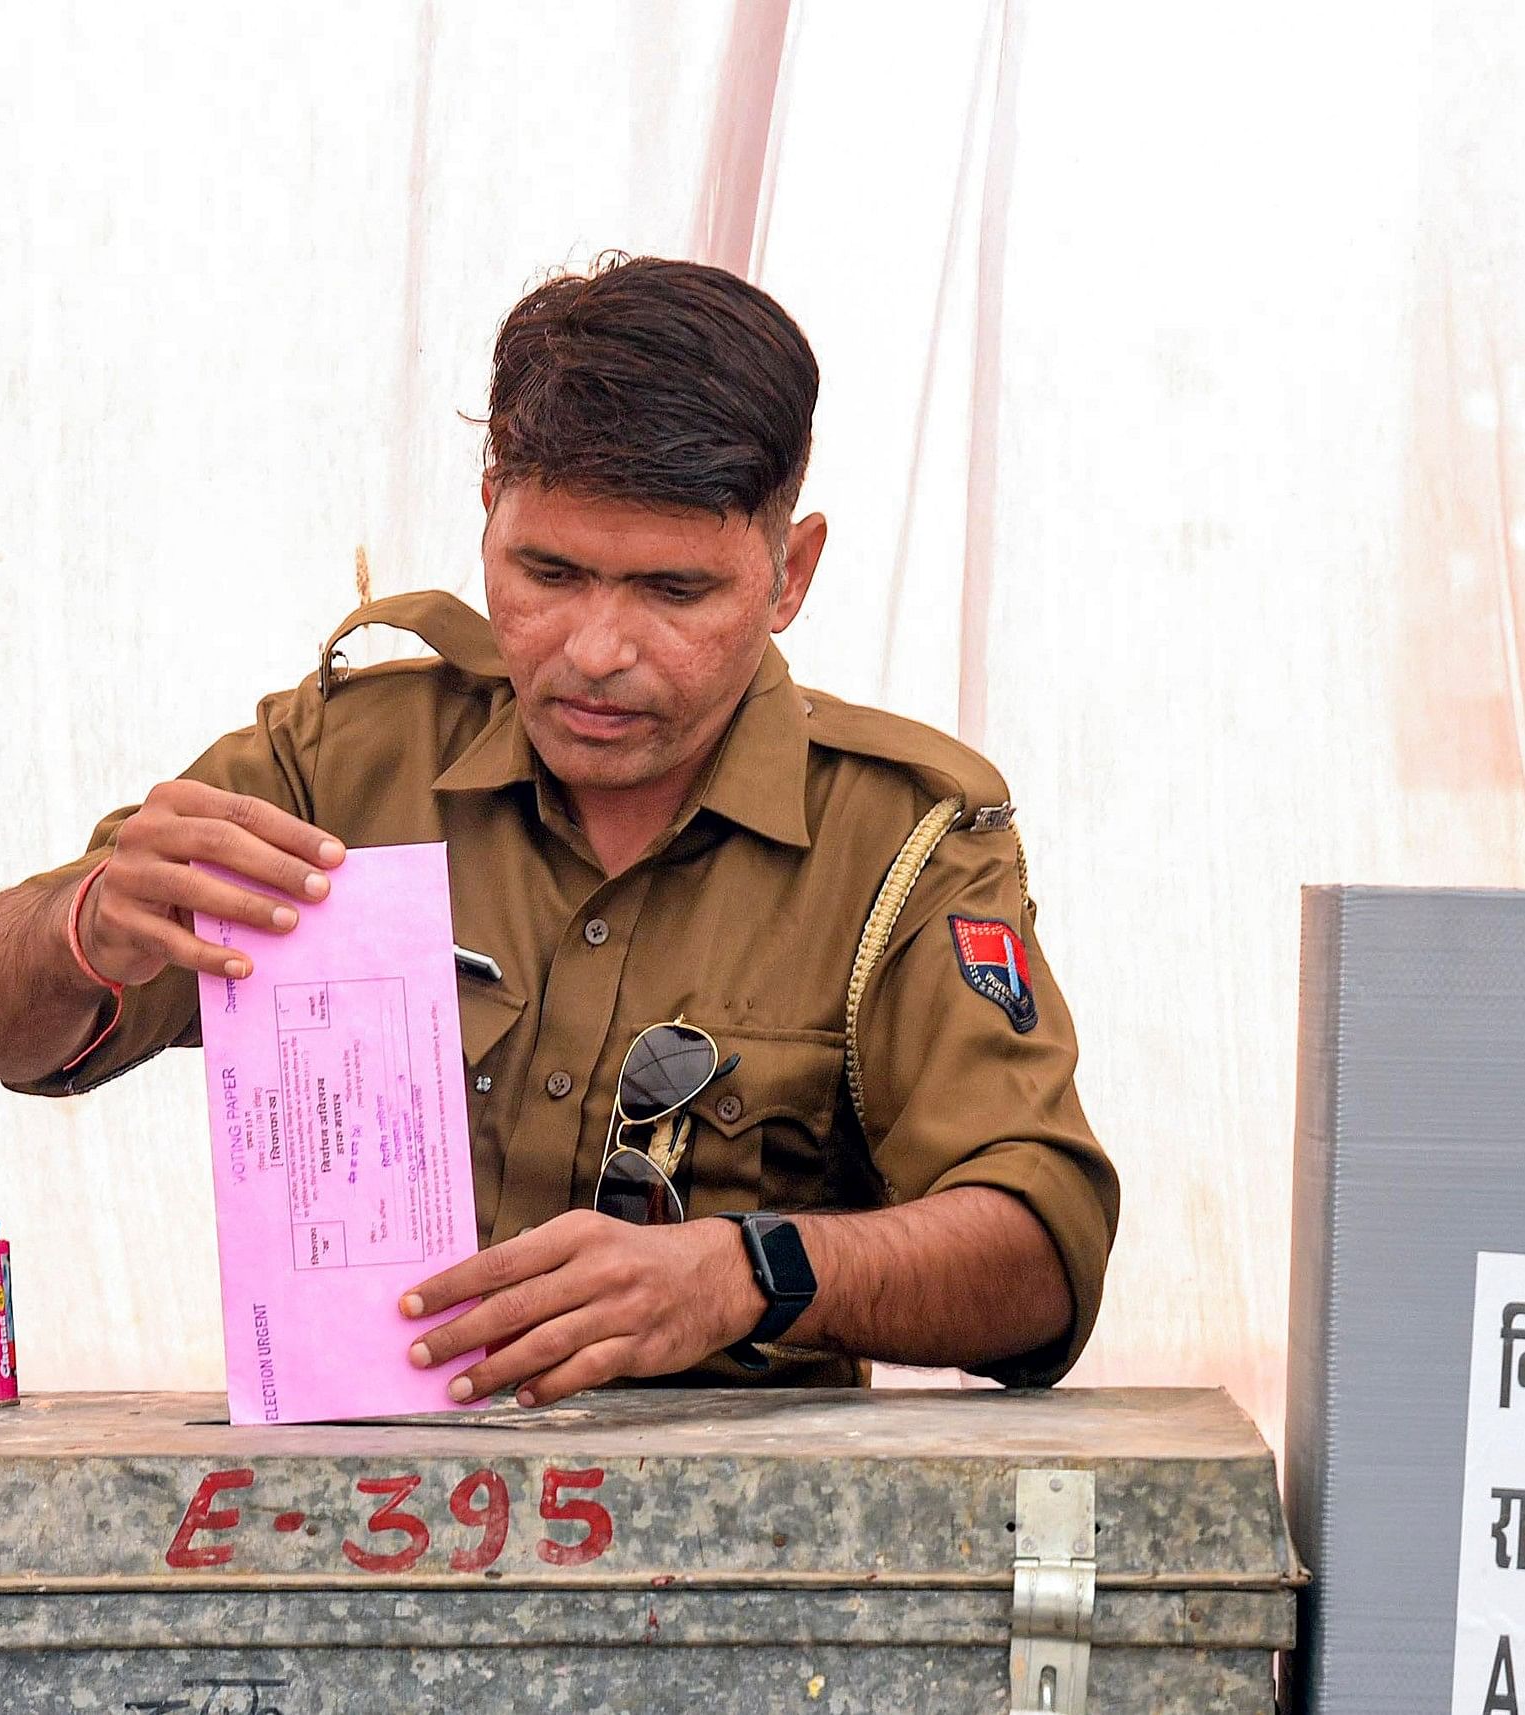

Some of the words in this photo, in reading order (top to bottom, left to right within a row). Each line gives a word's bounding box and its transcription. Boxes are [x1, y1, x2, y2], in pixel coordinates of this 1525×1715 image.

[222, 1067, 240, 1120] PAPER
[229, 1125, 247, 1185] VOTING
[253, 1303, 271, 1356] URGENT
[260, 1359, 279, 1421] ELECTION
